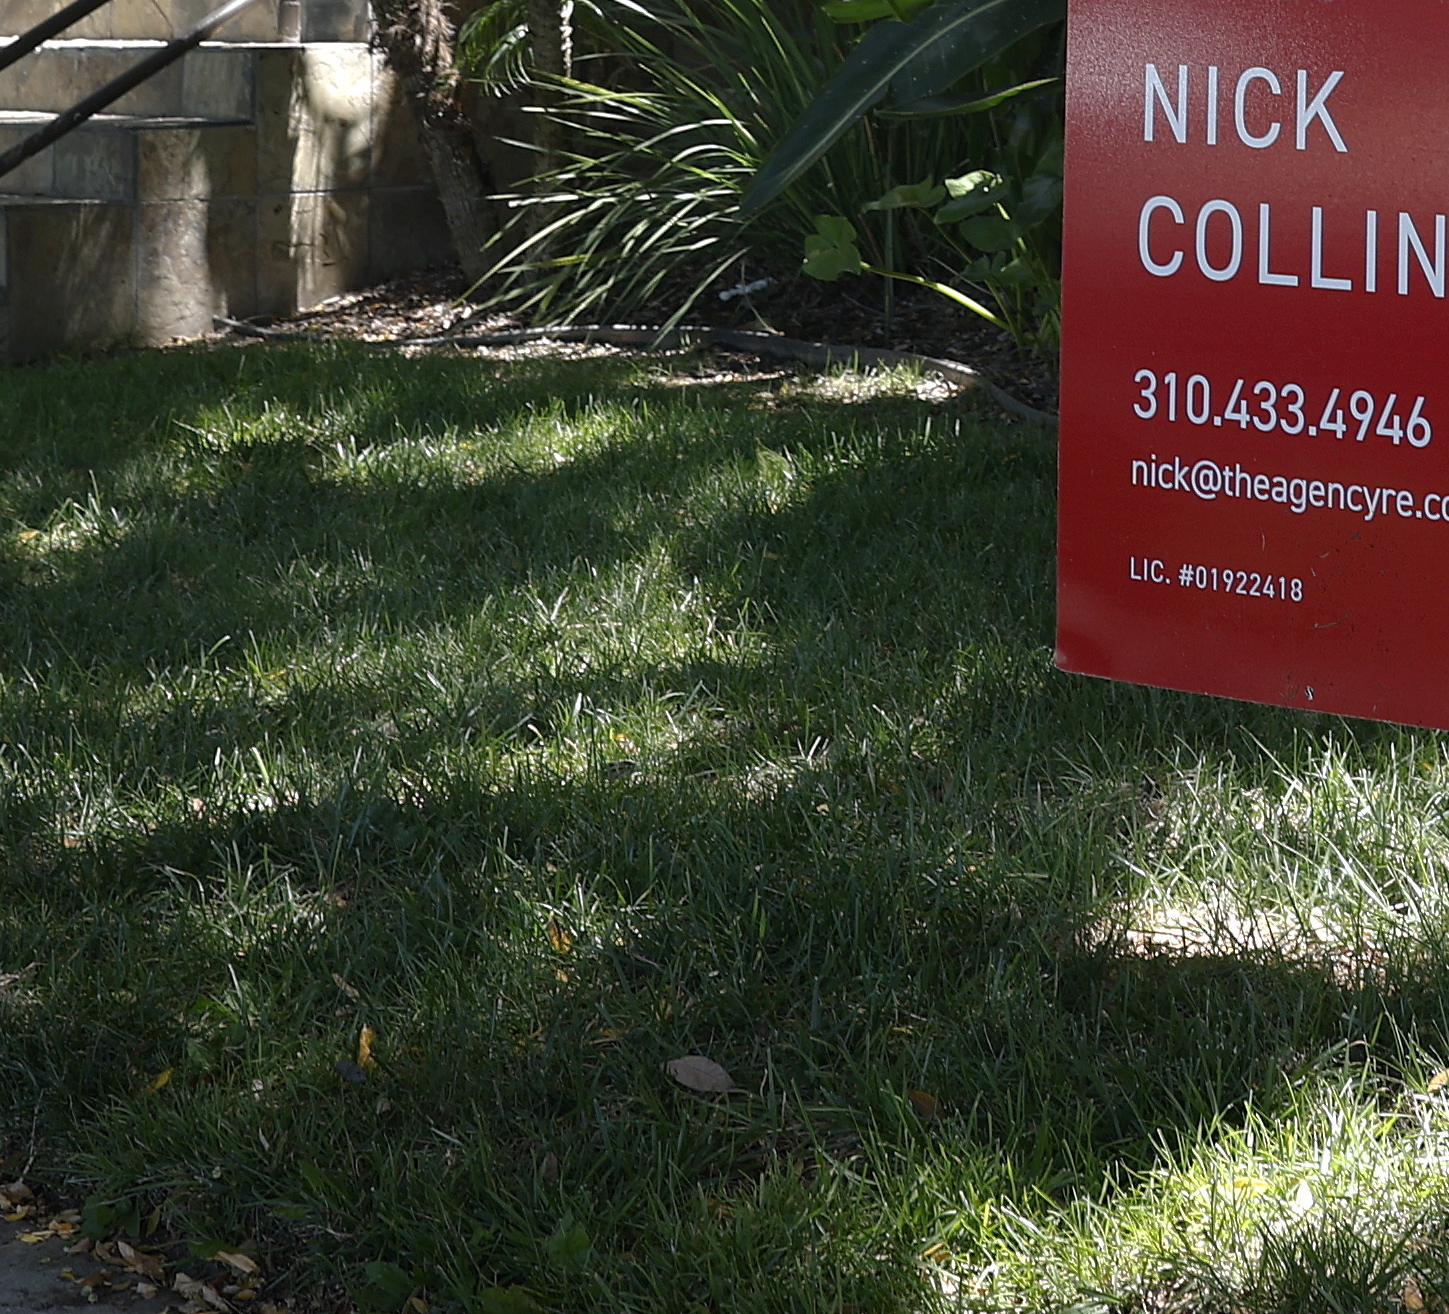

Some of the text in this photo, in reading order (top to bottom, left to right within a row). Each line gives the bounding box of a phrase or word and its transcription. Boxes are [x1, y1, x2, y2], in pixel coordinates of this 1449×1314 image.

[1143, 62, 1349, 154] NICK
[1132, 368, 1433, 448] 310.433.4946
[1129, 555, 1303, 602] LIC. #01922418
